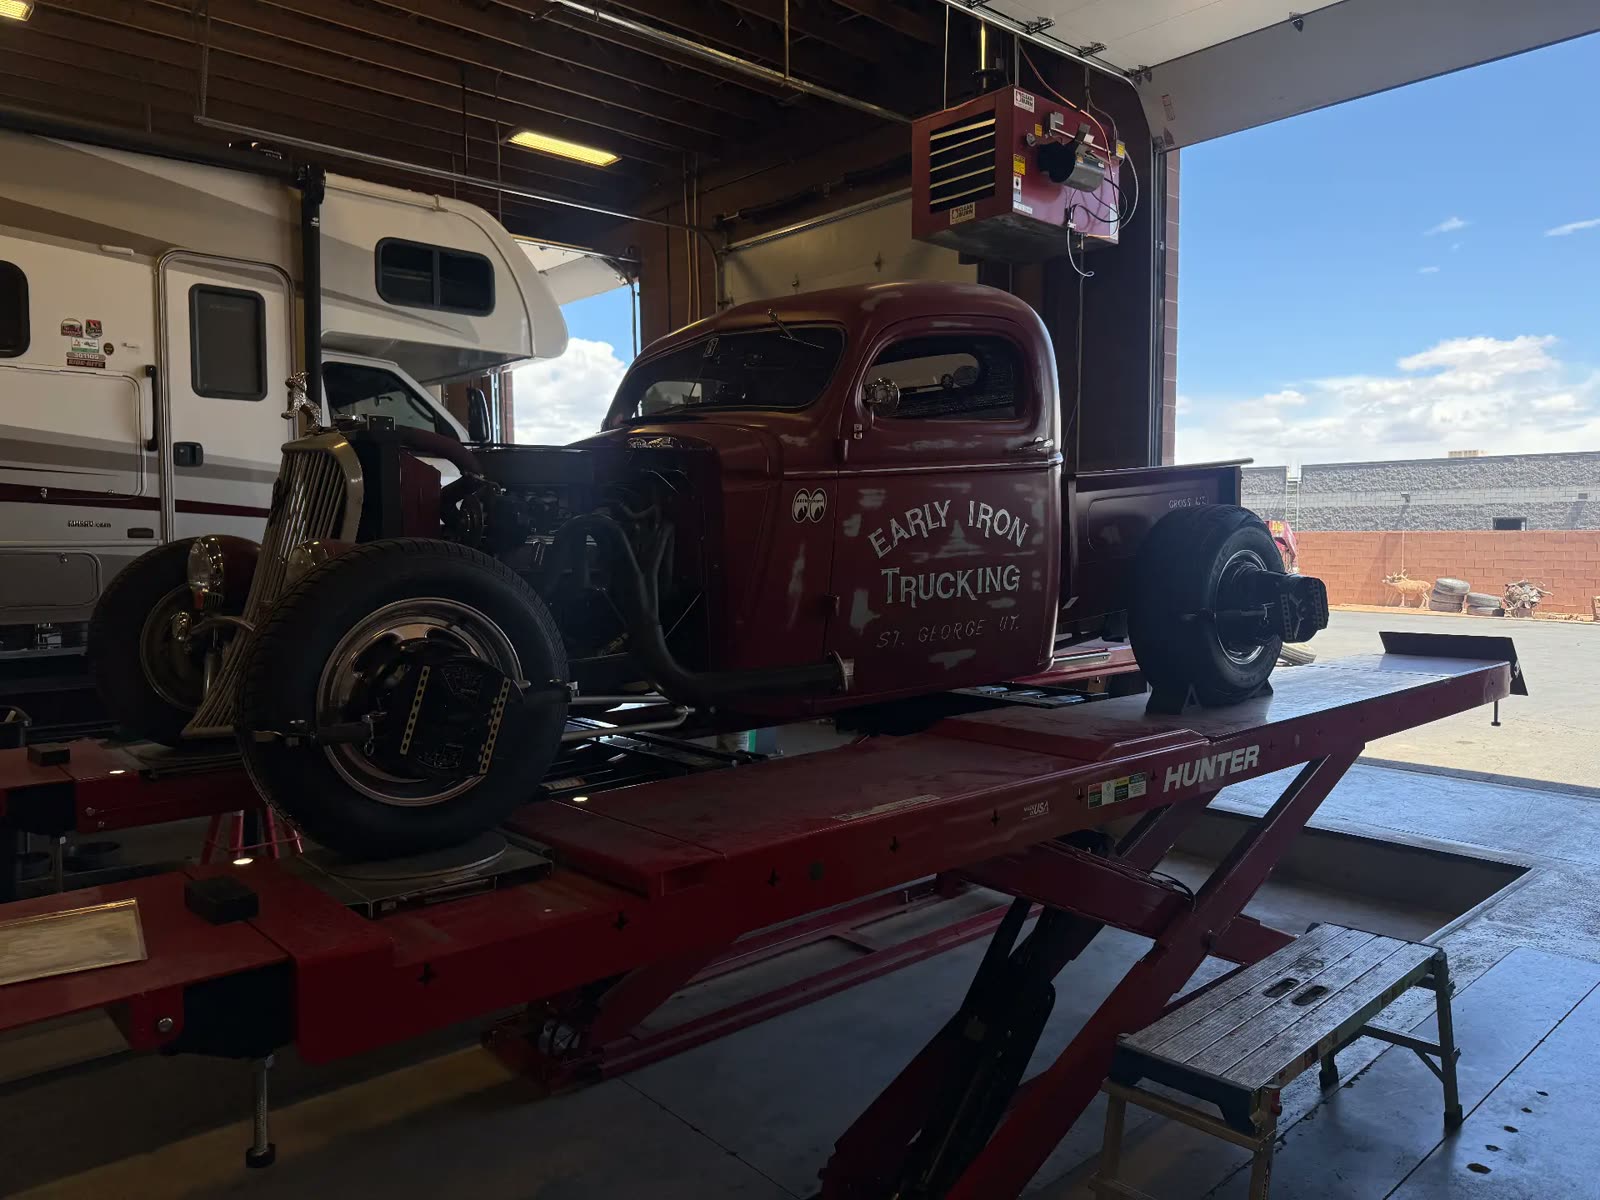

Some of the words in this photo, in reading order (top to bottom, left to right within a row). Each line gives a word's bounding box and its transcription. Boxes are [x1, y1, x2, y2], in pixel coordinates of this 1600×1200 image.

[1168, 498, 1191, 508] GROSS
[868, 499, 952, 559] EARLY
[967, 499, 1030, 548] IRON
[880, 564, 1021, 609] TRUCKING
[876, 630, 905, 649] ST.
[917, 618, 986, 644] GEORGE
[1163, 744, 1261, 793] HUNTER
[1034, 800, 1049, 814] USA
